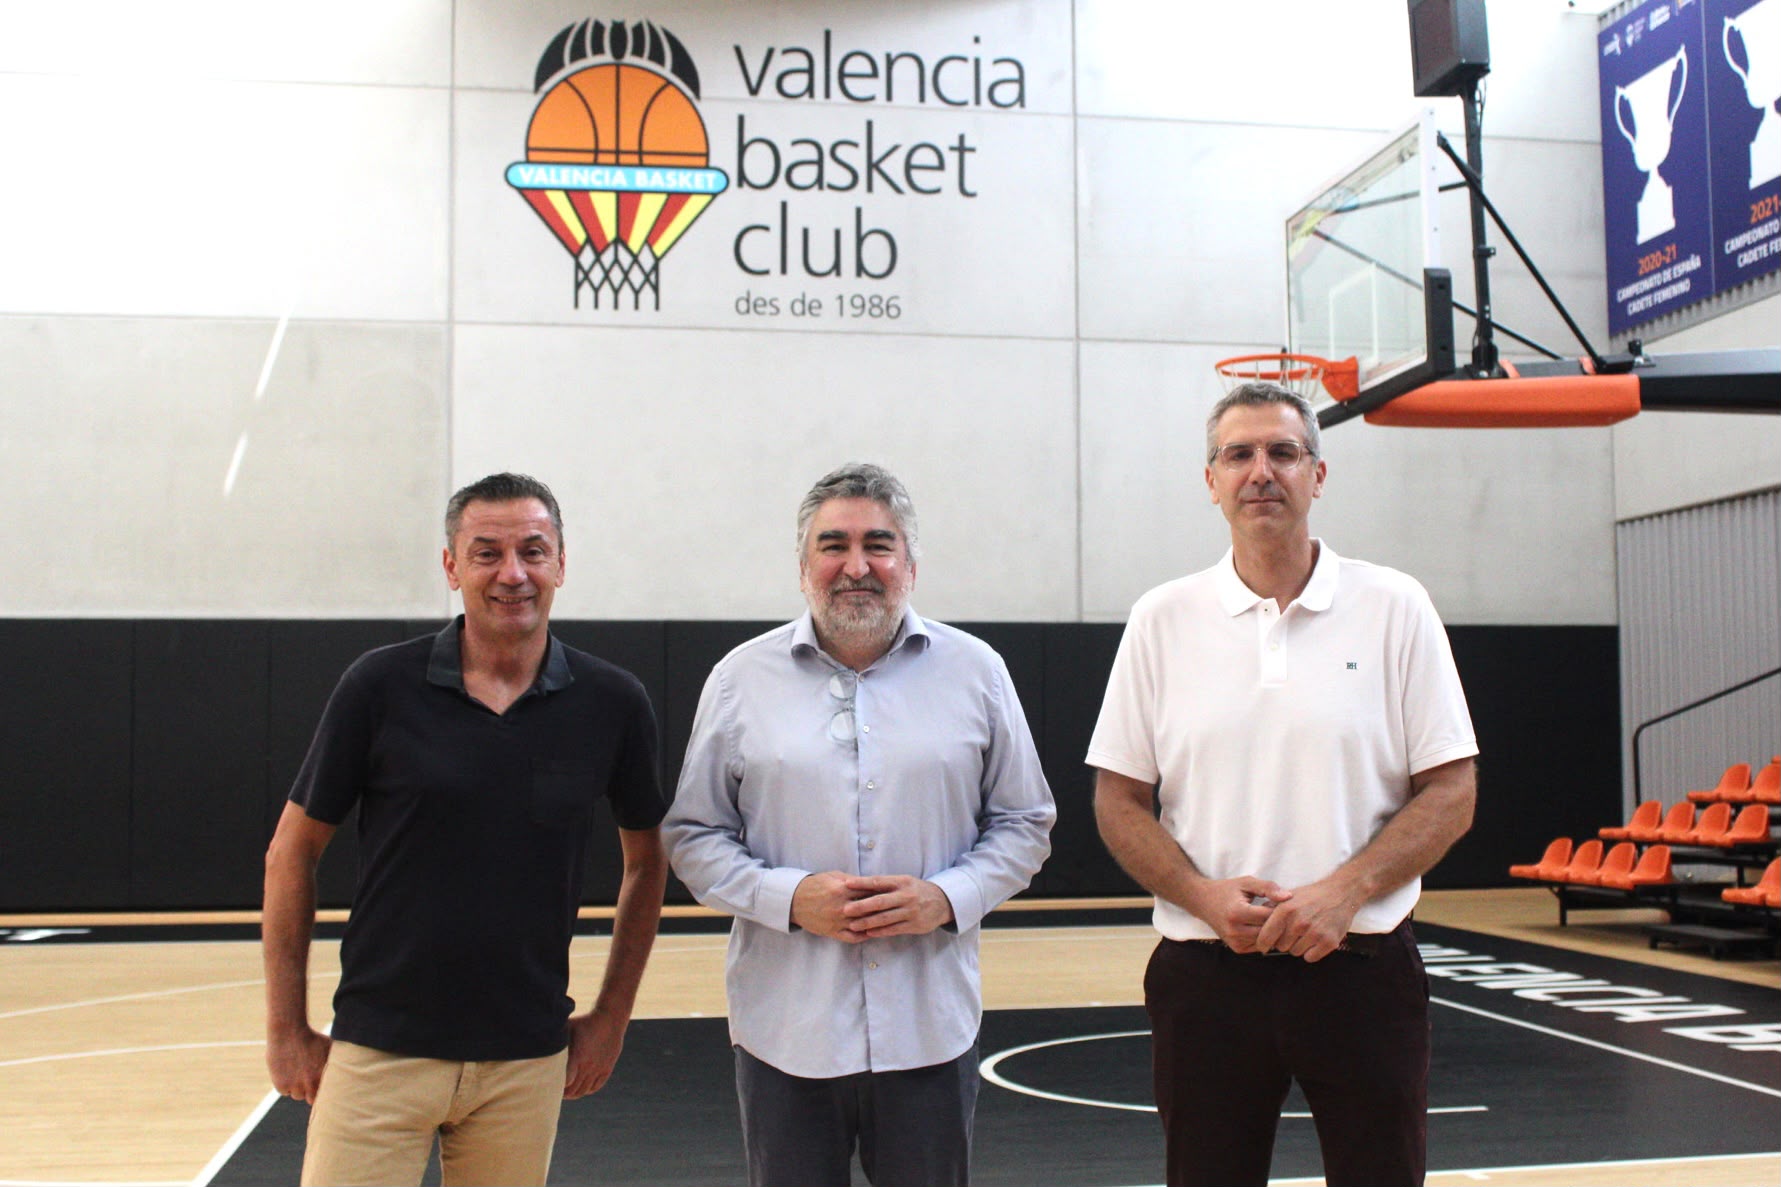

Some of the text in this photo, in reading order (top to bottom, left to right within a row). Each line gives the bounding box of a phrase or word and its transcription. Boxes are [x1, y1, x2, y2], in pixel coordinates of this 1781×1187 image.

[733, 29, 1026, 109] valencia
[736, 114, 978, 198] basket
[519, 167, 716, 190] VALENCIA BASKET
[734, 200, 898, 280] club
[1725, 218, 1780, 255] CAMPEONATO
[1638, 244, 1677, 276] 2020-21
[1737, 242, 1768, 268] CADETE
[1617, 254, 1701, 303] CAMPEONATO DE ESPAÑA
[735, 291, 902, 319] des de 1986
[1627, 294, 1653, 316] CADETE
